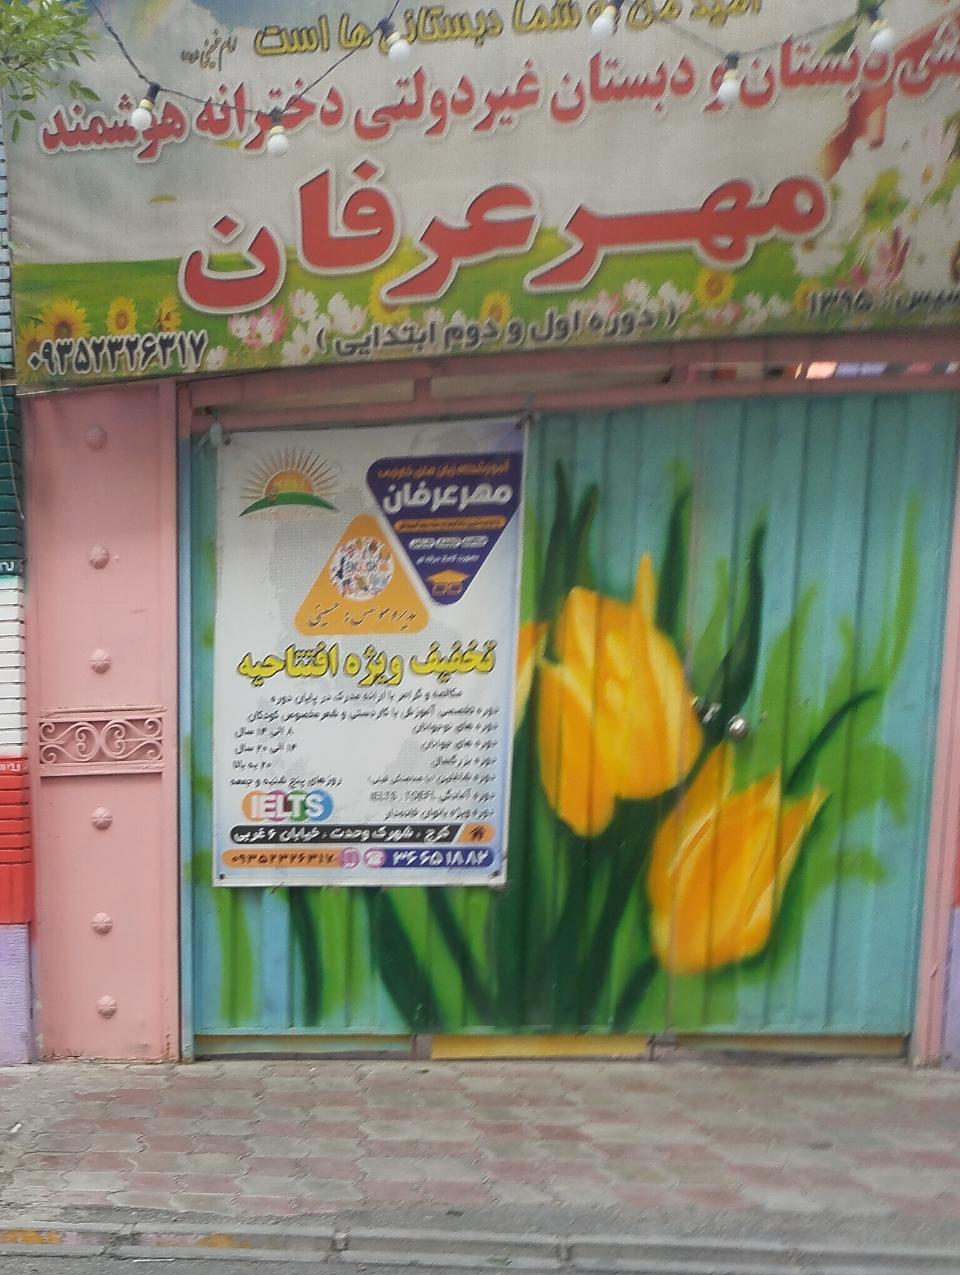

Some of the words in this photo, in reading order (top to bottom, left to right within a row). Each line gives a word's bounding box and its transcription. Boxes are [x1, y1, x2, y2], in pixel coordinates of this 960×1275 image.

[254, 14, 330, 57] است
[550, 50, 697, 125] دبستان
[41, 93, 188, 162] هوشمند
[180, 154, 538, 314] عرفان
[524, 172, 832, 296] مهر
[335, 320, 436, 357] ابتدایی
[444, 320, 500, 349] دوم
[507, 318, 526, 346] و
[532, 308, 579, 344] اول
[27, 330, 209, 375] ۰۹۳۵۲۳۲۶۳۱۷
[382, 480, 459, 515] عرفان
[457, 482, 514, 512] مهر
[237, 641, 339, 687] افتتاحیه
[344, 645, 405, 686] ویژه
[409, 639, 497, 685] تخفیف
[250, 792, 325, 819] IELTS
[279, 826, 321, 843] خیابان
[329, 827, 371, 844] وحدت
